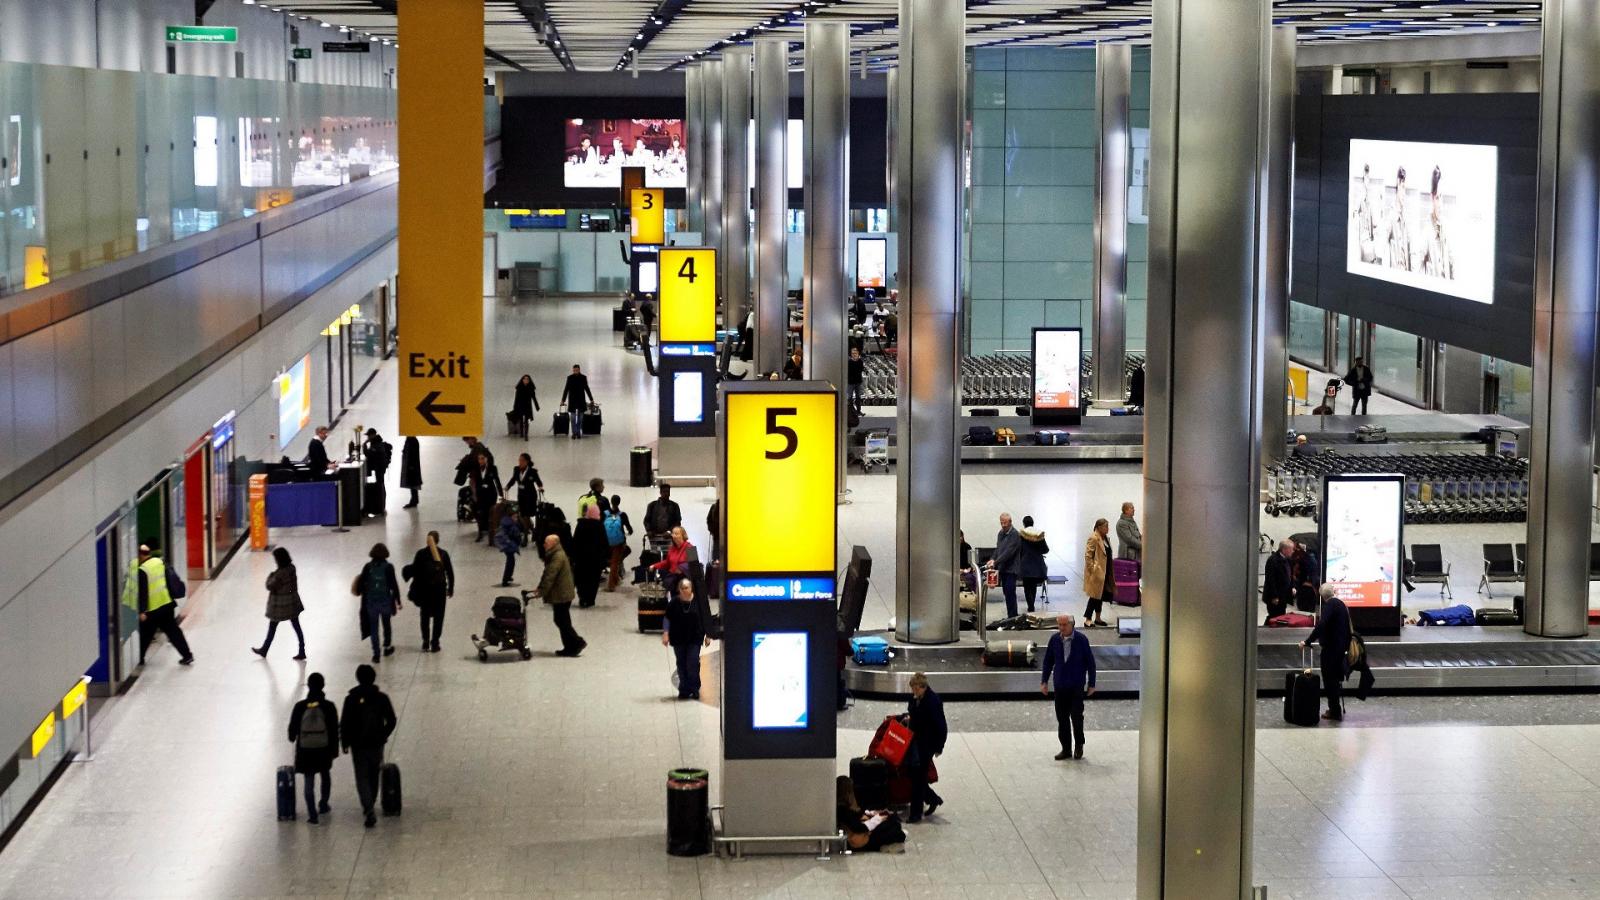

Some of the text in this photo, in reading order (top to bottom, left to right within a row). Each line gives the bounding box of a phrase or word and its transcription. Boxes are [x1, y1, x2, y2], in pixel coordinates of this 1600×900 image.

[642, 193, 653, 209] 3
[678, 257, 697, 283] 4
[409, 351, 470, 379] Exit
[765, 408, 797, 459] 5
